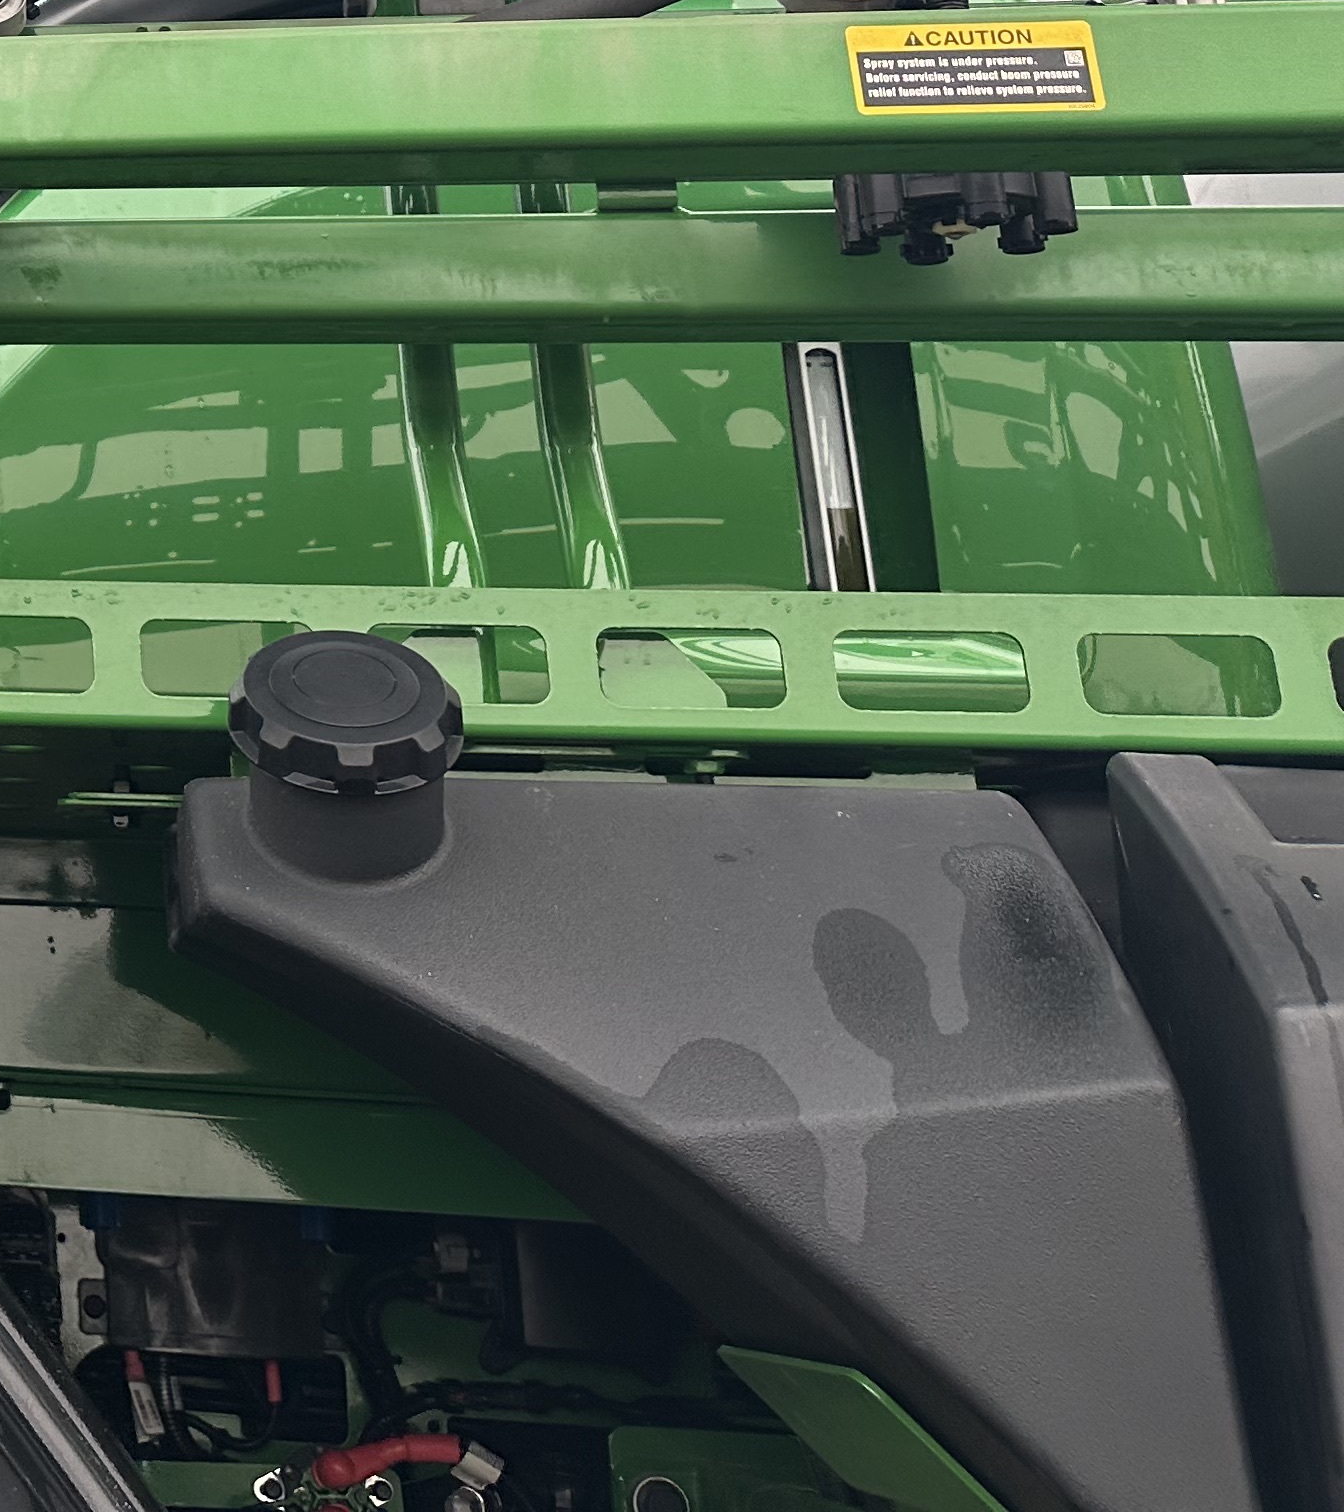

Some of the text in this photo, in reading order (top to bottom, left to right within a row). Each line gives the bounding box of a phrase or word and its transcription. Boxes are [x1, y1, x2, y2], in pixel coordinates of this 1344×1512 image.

[925, 29, 1033, 46] CAUTION
[863, 55, 1039, 70] Spray system is under pressure.
[865, 69, 1080, 83] Before servicing, conduct boom pressure
[868, 84, 1087, 97] relief function to relieve system pressure.
